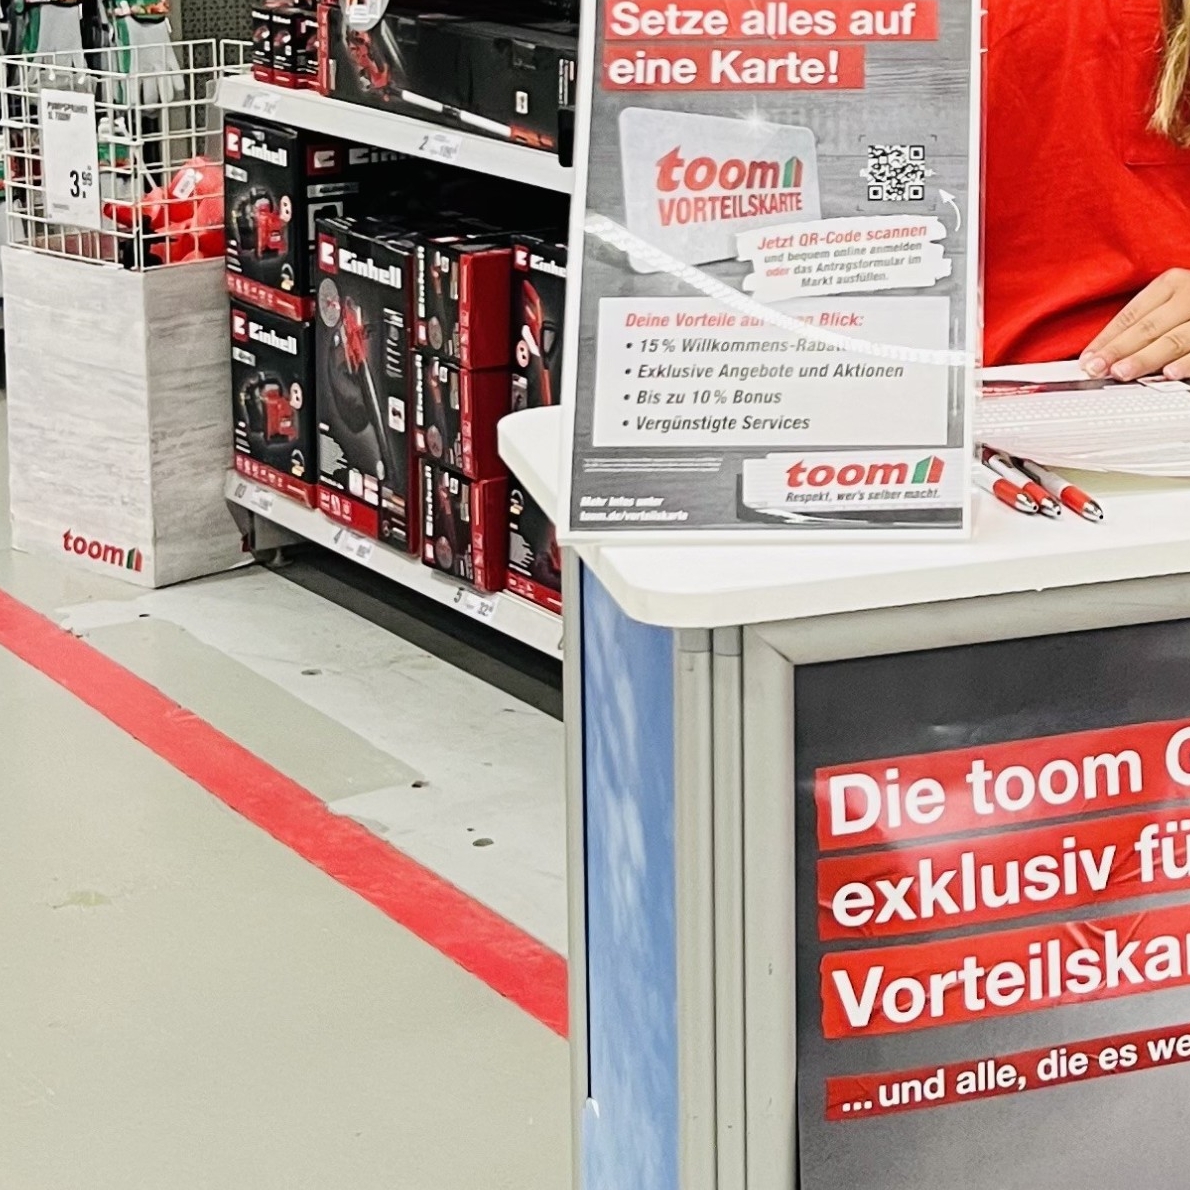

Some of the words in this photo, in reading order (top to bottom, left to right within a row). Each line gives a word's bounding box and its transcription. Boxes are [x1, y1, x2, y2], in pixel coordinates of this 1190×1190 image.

[610, 1, 729, 36] Setze
[740, 1, 837, 36] alles
[849, 1, 917, 36] auf
[608, 51, 697, 85] eine
[710, 50, 839, 85] Karte!
[241, 137, 288, 167] Einhell
[656, 146, 781, 193] toom
[657, 192, 804, 227] VORTEILSKARTE
[757, 237, 794, 251] Jetzt
[800, 230, 861, 247] QR-Code
[866, 226, 927, 241] scannen
[764, 252, 784, 263] und
[787, 249, 830, 262] bequem
[833, 245, 867, 257] online
[869, 241, 922, 255] anmelden
[339, 247, 402, 289] Einhell
[766, 267, 790, 277] oder
[793, 263, 812, 275] das
[816, 256, 906, 273] Antragsformular
[908, 255, 922, 265] im
[801, 276, 834, 288] Markt
[836, 272, 889, 285] ausfüllen.
[625, 312, 670, 328] Deine
[675, 312, 736, 328] Vorteile
[819, 312, 864, 328] Blick:
[249, 322, 298, 355] Einhell
[637, 363, 714, 379] Exklusive
[718, 363, 794, 382] Angebote
[798, 363, 829, 379] und
[833, 363, 904, 379] Aktionen
[636, 390, 661, 405] Bis
[666, 393, 686, 405] zu
[732, 390, 782, 405] Bonus
[636, 415, 737, 433] Vergünstigte
[742, 415, 810, 431] Services
[786, 459, 909, 488] toom
[785, 491, 833, 503] Respekt,
[836, 491, 864, 502] wer's
[868, 490, 901, 501] selber
[904, 489, 941, 500] macht.
[63, 530, 125, 565] toom
[829, 769, 946, 836] Die
[966, 748, 1143, 816] toom
[832, 837, 1117, 927] exklusiv
[956, 1059, 1027, 1093] alle,
[1036, 1048, 1089, 1080] die
[1098, 1044, 1138, 1069] es
